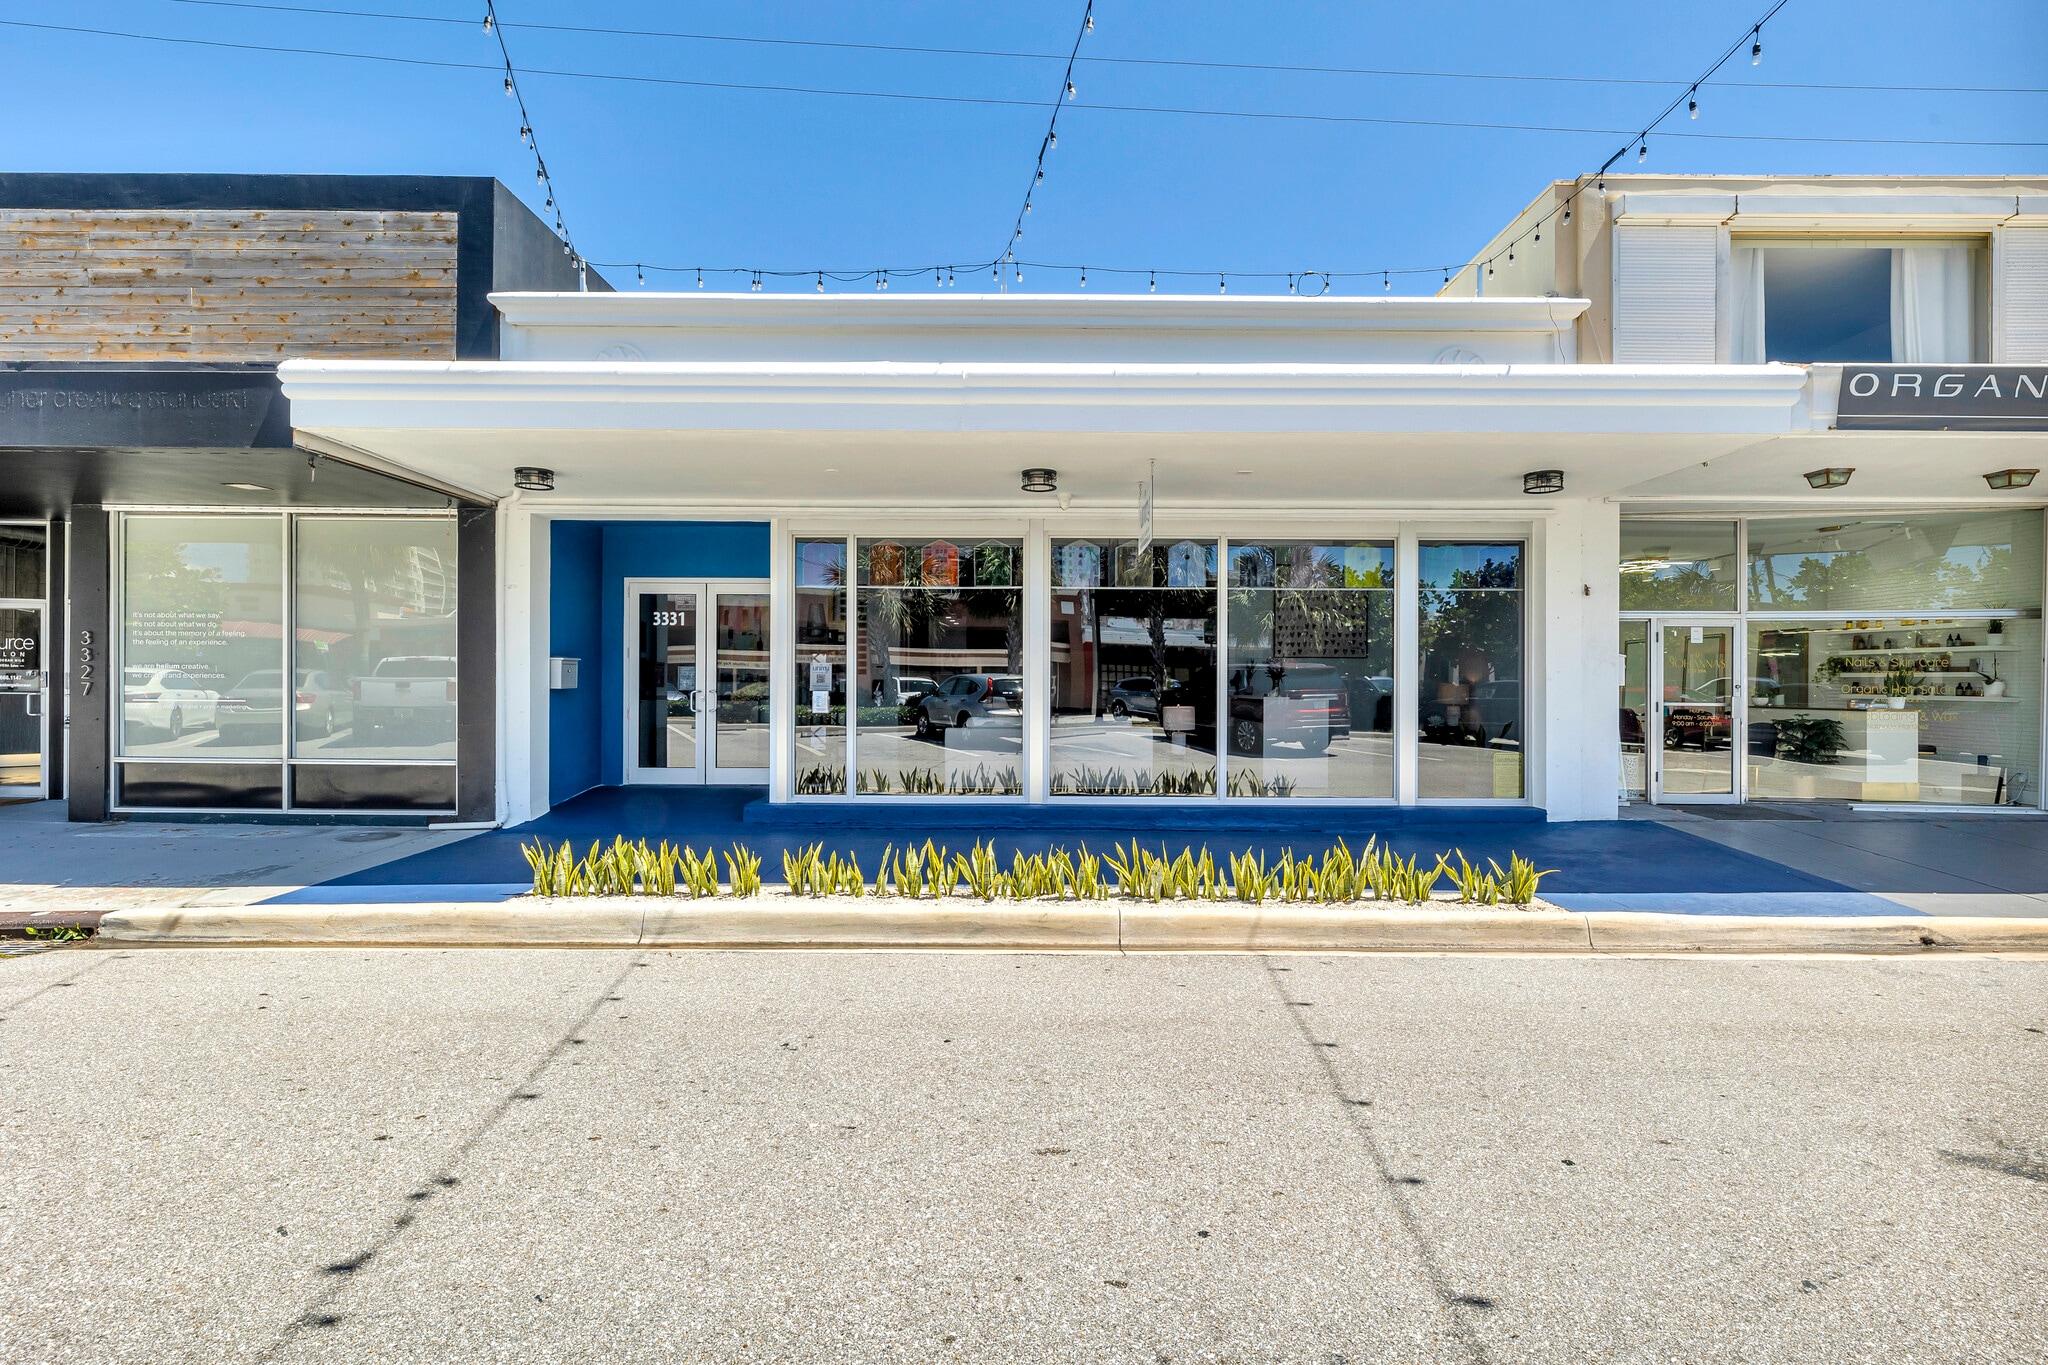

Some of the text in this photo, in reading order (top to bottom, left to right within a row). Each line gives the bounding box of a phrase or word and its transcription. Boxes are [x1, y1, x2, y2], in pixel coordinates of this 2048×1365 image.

[1849, 372, 2048, 398] ORGAN
[653, 611, 685, 626] 3331
[222, 630, 246, 638] feeling.
[81, 631, 91, 696] 3327
[1845, 657, 1950, 668] Nails & Skin Care
[1841, 684, 1888, 696] Organic
[1920, 711, 1929, 721] &
[1932, 711, 1959, 721] Wax
